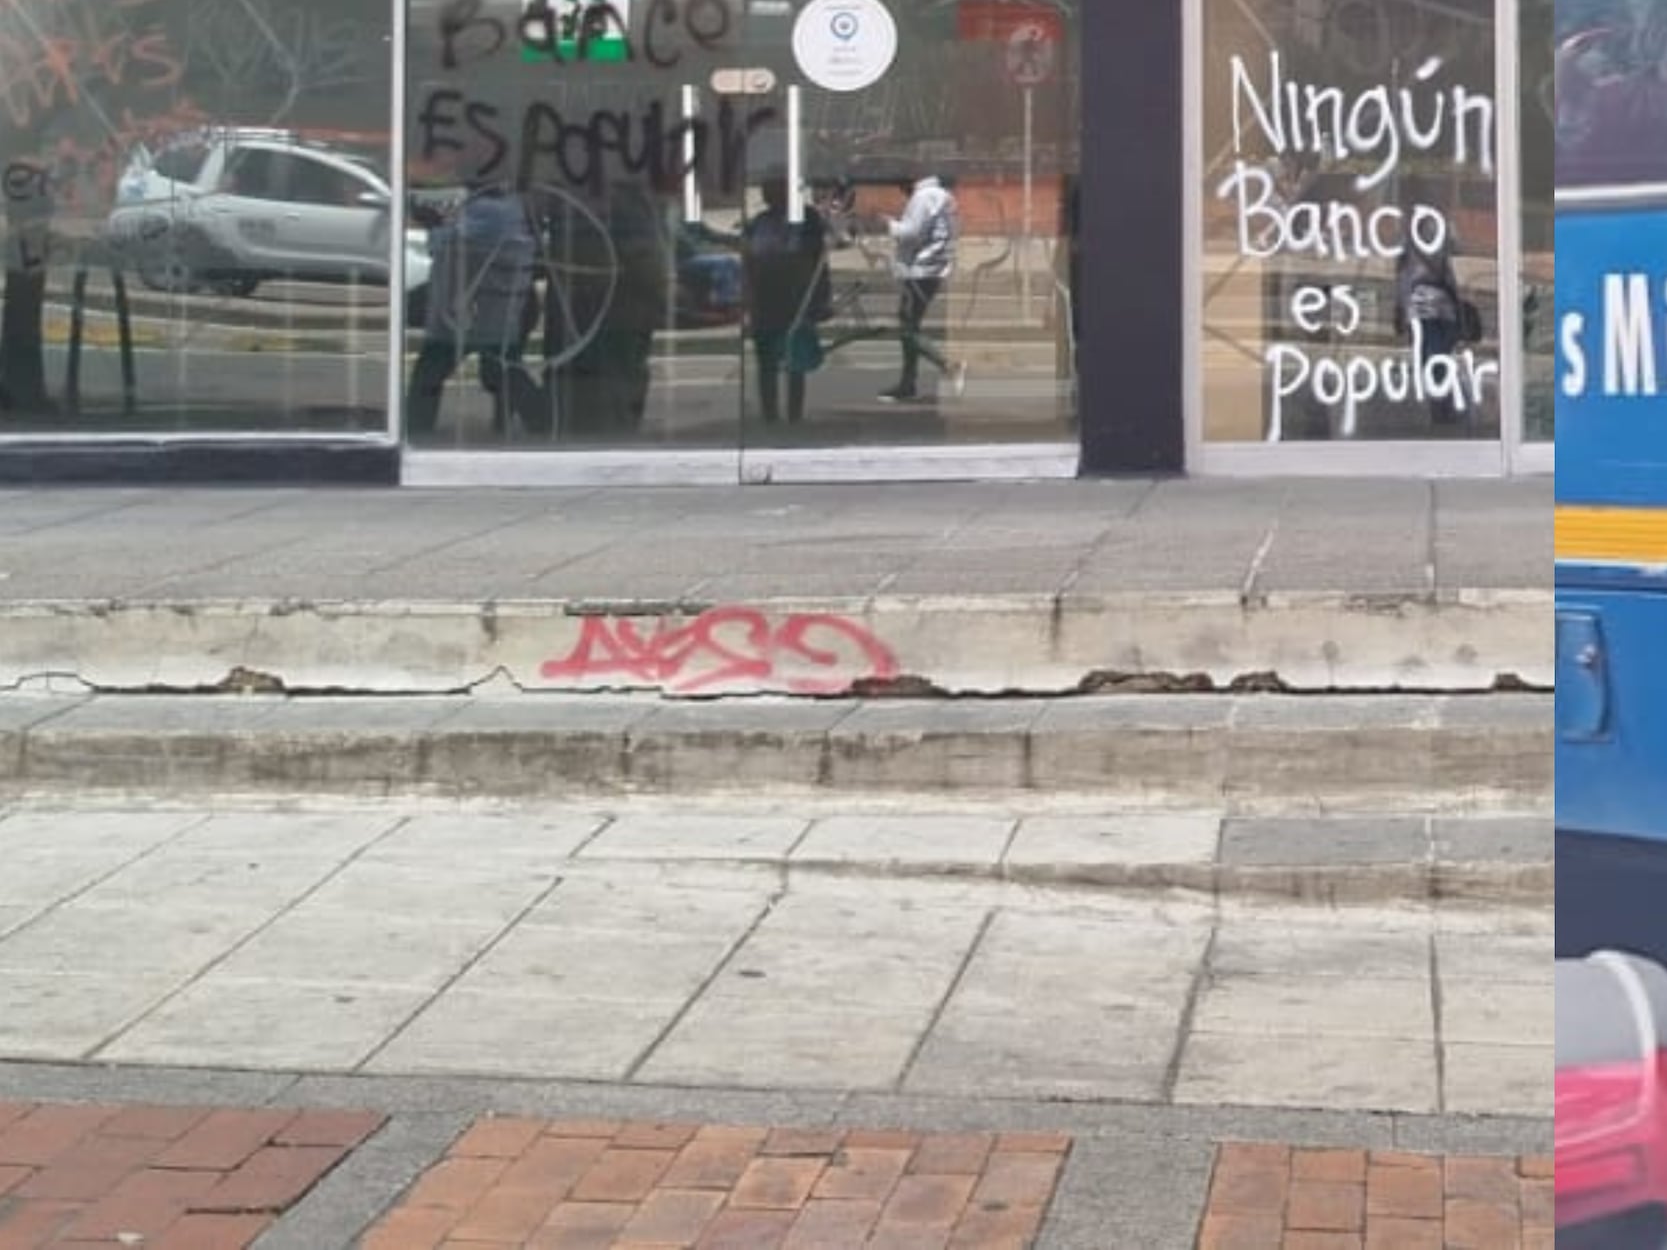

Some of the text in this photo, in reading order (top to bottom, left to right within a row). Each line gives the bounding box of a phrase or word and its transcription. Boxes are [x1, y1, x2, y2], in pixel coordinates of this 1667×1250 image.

[1230, 49, 1496, 191] Ningún
[1217, 159, 1447, 262] Banco
[1291, 283, 1361, 334] es
